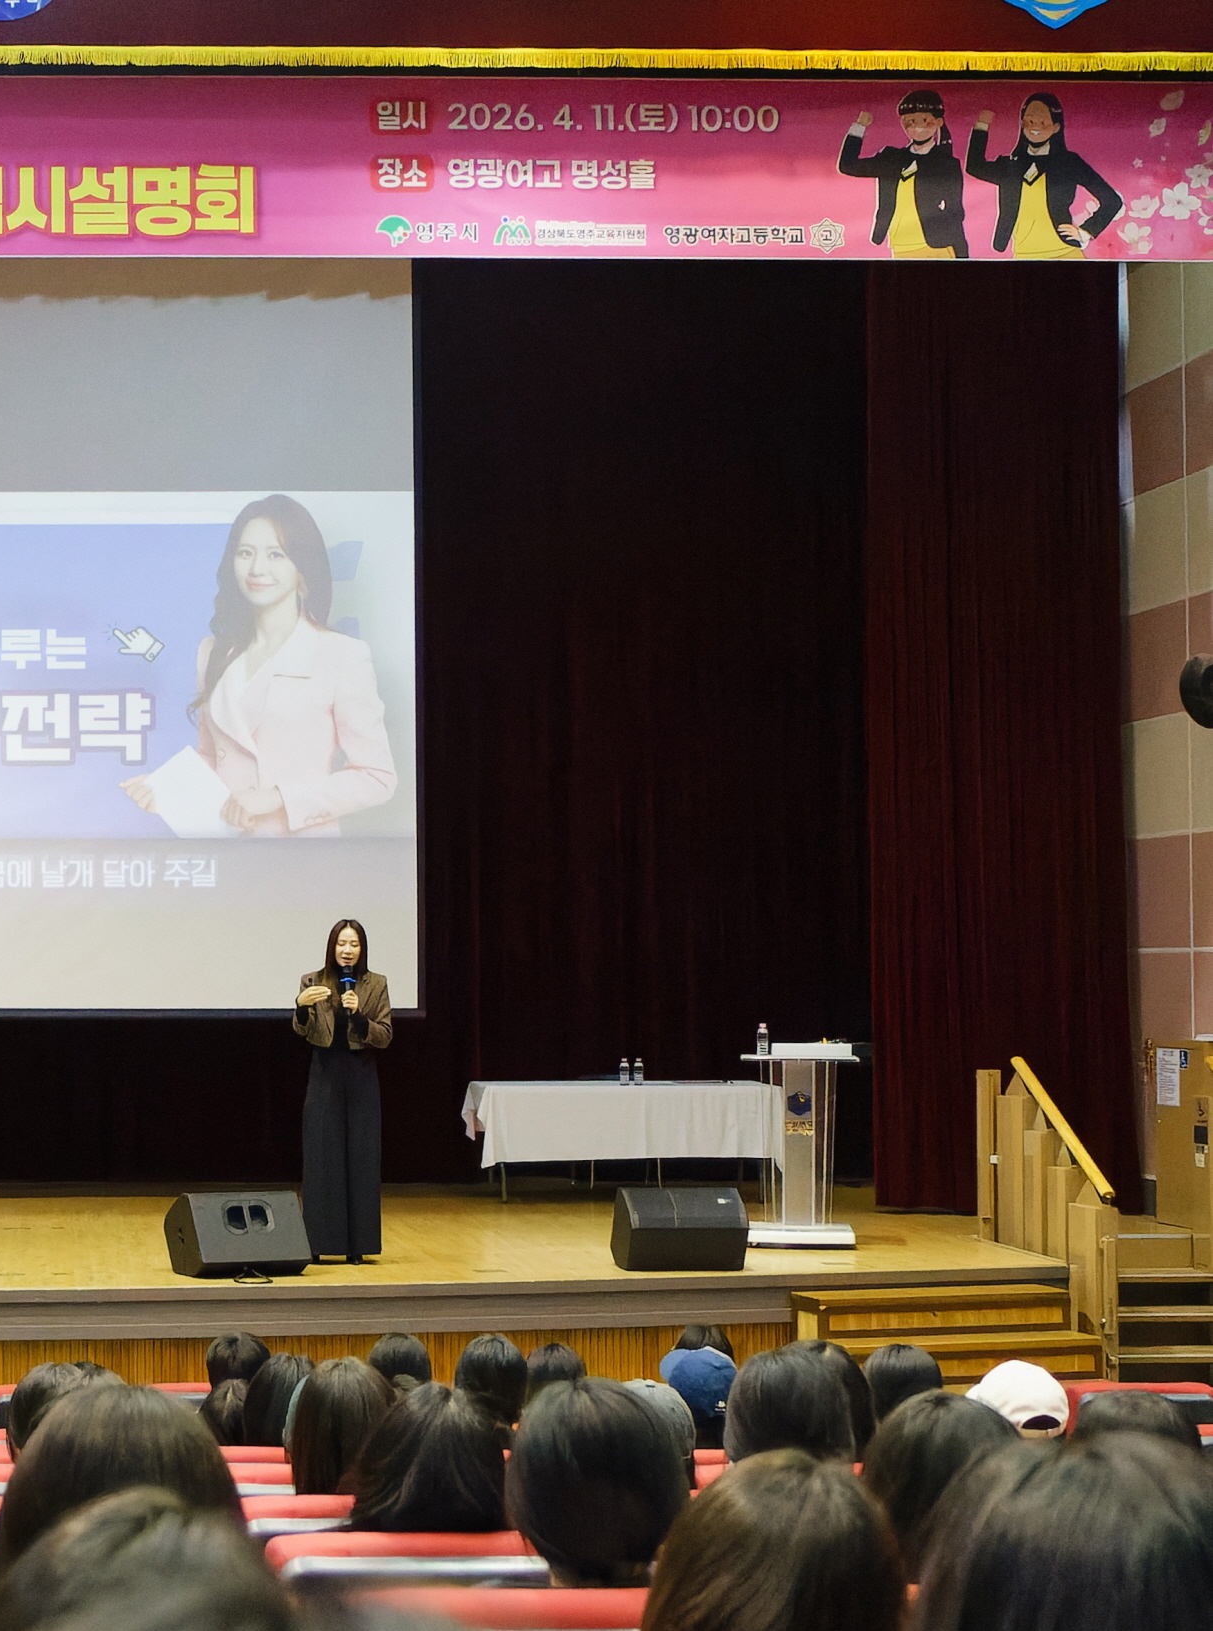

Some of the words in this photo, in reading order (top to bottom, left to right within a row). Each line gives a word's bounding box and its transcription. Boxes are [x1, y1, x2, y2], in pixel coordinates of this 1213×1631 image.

[376, 101, 426, 131] 일시
[447, 102, 544, 132] 2026.
[552, 103, 583, 131] 4.
[688, 104, 780, 133] 10:00
[377, 158, 428, 189] 장소
[447, 158, 562, 190] 영광여고
[570, 159, 656, 190] 명성홀
[416, 222, 479, 243] 영주시
[536, 227, 646, 240] 경상북도영주교육지원청
[663, 226, 805, 245] 영광여자고등학교
[0, 691, 153, 764] 전략
[40, 858, 94, 889] 날개
[102, 858, 156, 889] 달아
[162, 858, 218, 889] 주길
